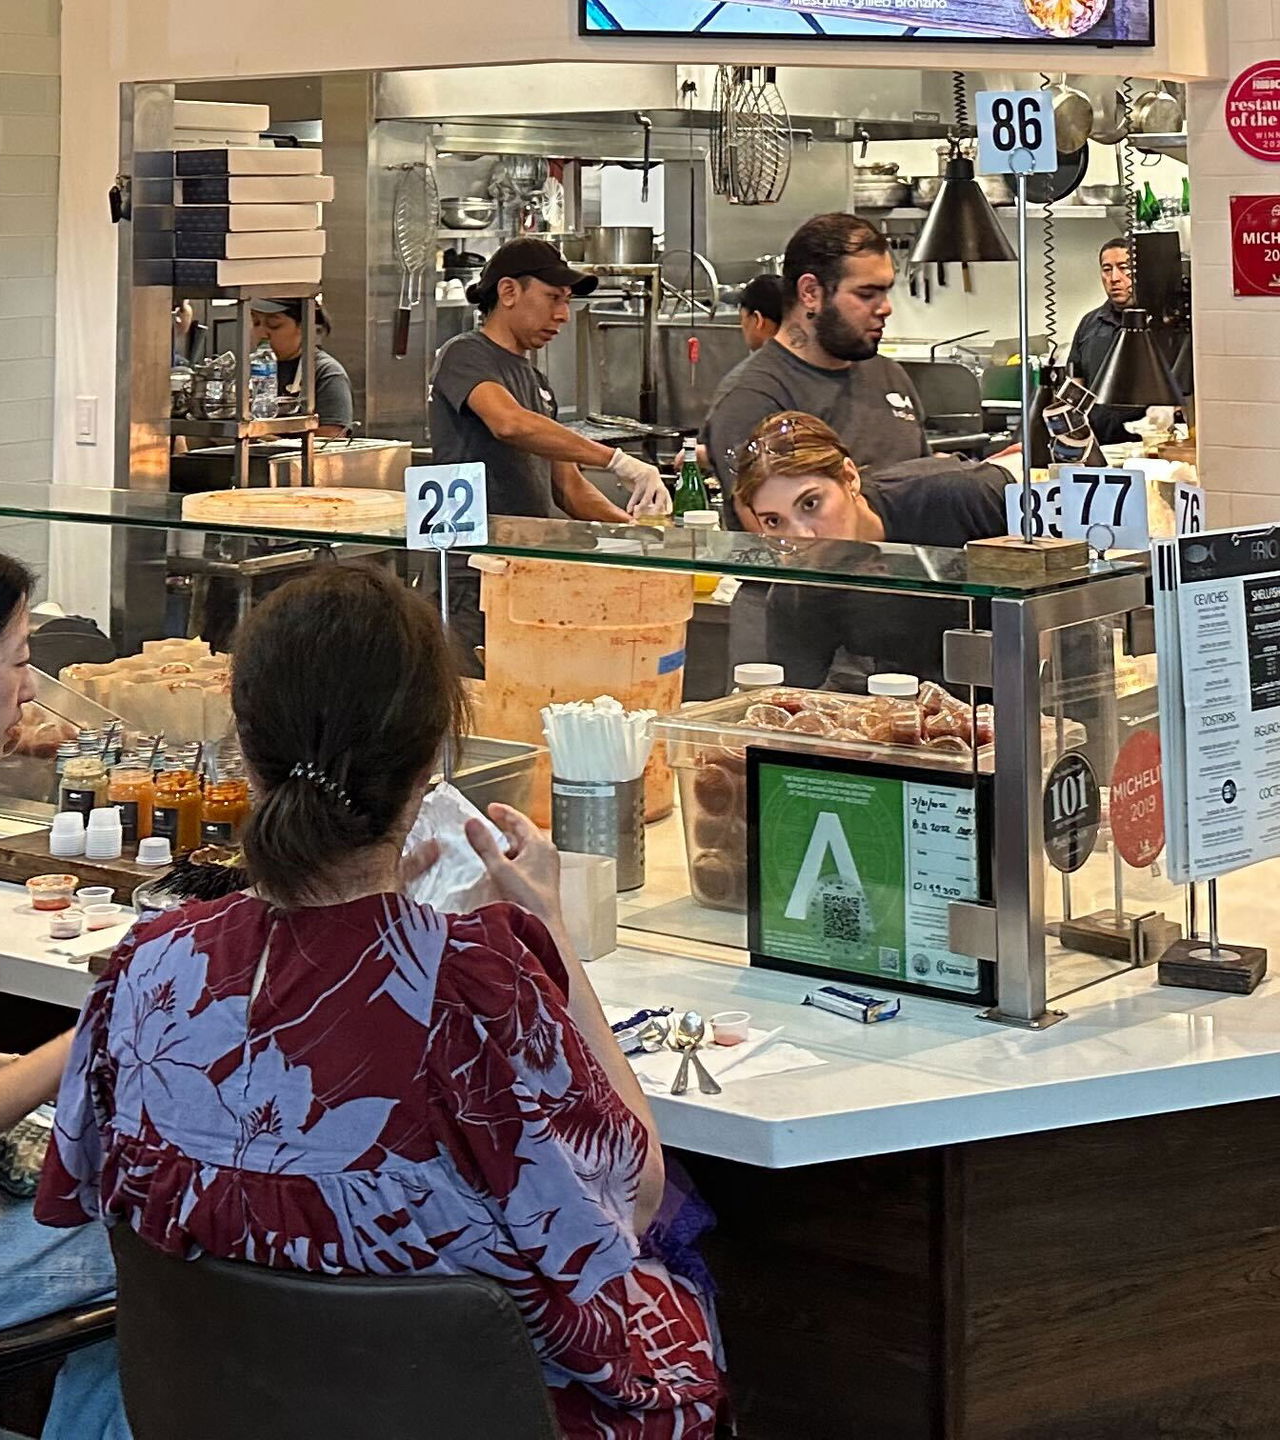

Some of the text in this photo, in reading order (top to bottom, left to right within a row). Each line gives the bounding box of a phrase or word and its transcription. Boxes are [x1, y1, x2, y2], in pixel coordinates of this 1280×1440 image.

[991, 97, 1043, 152] 86
[1230, 111, 1249, 128] of
[1249, 111, 1279, 127] the
[418, 478, 475, 535] 22
[1019, 488, 1063, 540] 83
[1072, 473, 1133, 528] 77
[1180, 489, 1201, 536] 76
[1250, 538, 1280, 561] FRIO
[1194, 590, 1229, 607] CEVICHES
[1049, 769, 1089, 823] 101
[1112, 764, 1163, 804] MICHELI
[1130, 794, 1157, 822] 2019
[784, 811, 874, 933] A
